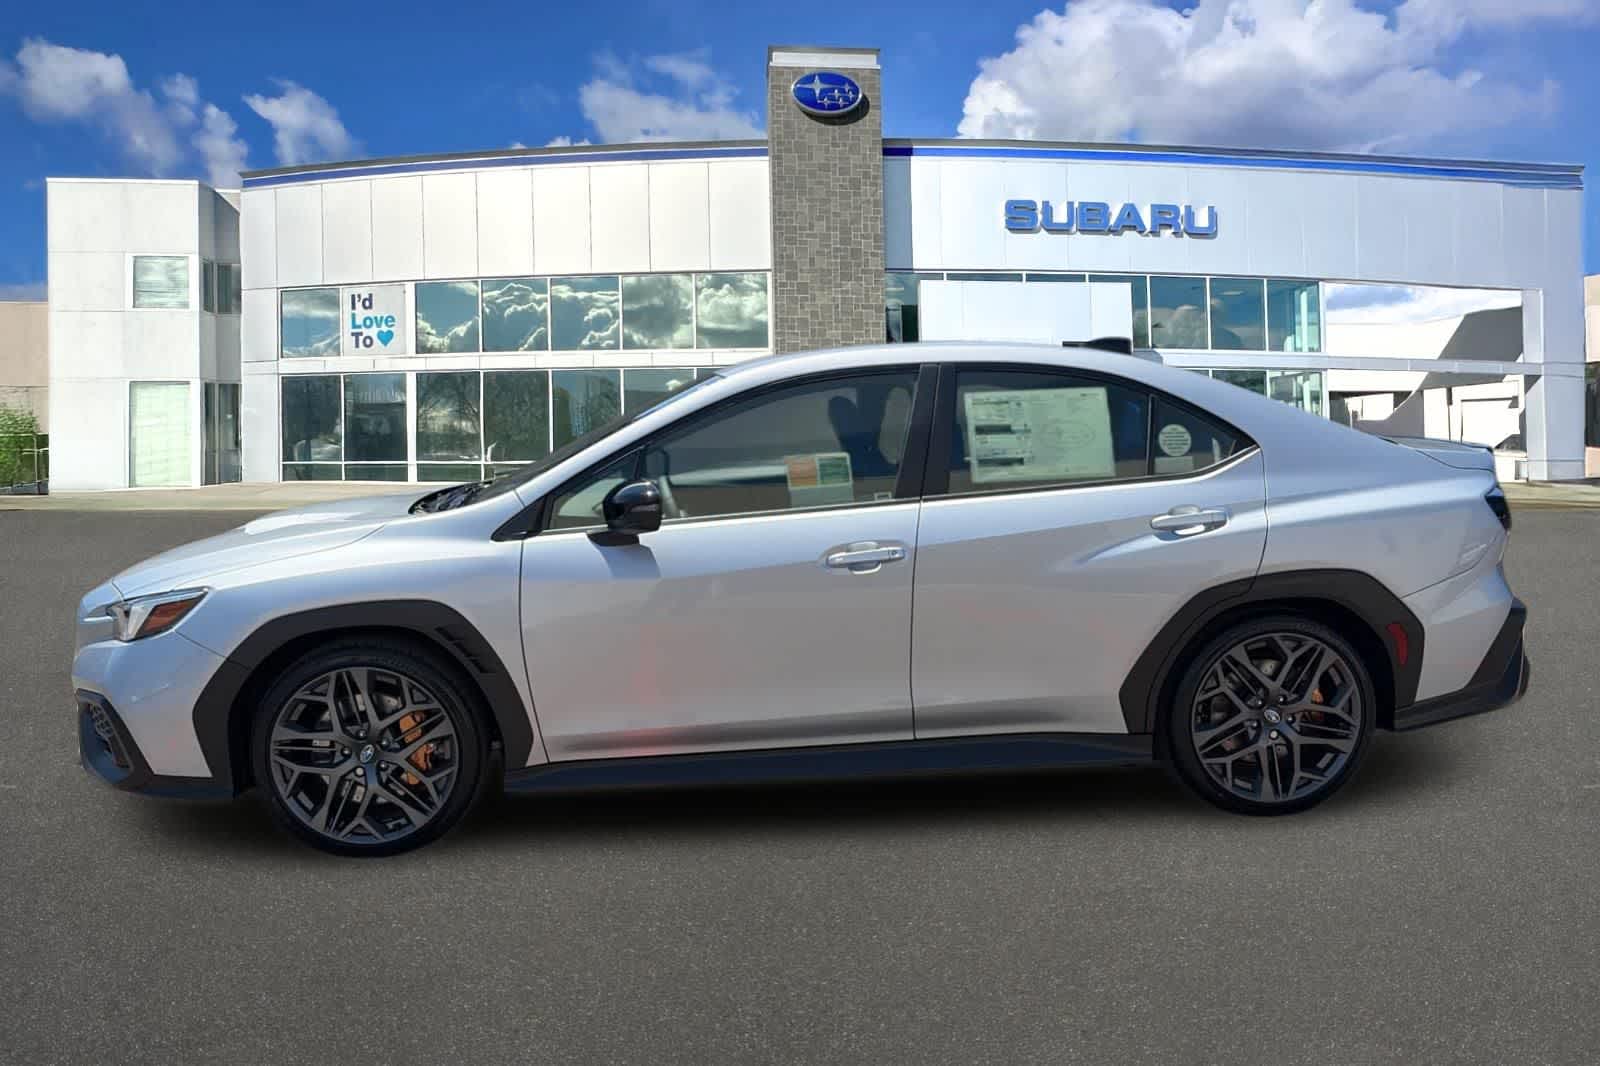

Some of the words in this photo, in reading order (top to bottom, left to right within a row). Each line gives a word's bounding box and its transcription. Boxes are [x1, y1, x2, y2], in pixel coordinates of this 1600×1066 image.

[1004, 199, 1217, 237] SUBARU
[351, 293, 373, 310] I'd
[351, 312, 396, 329] Love
[351, 331, 374, 348] To
